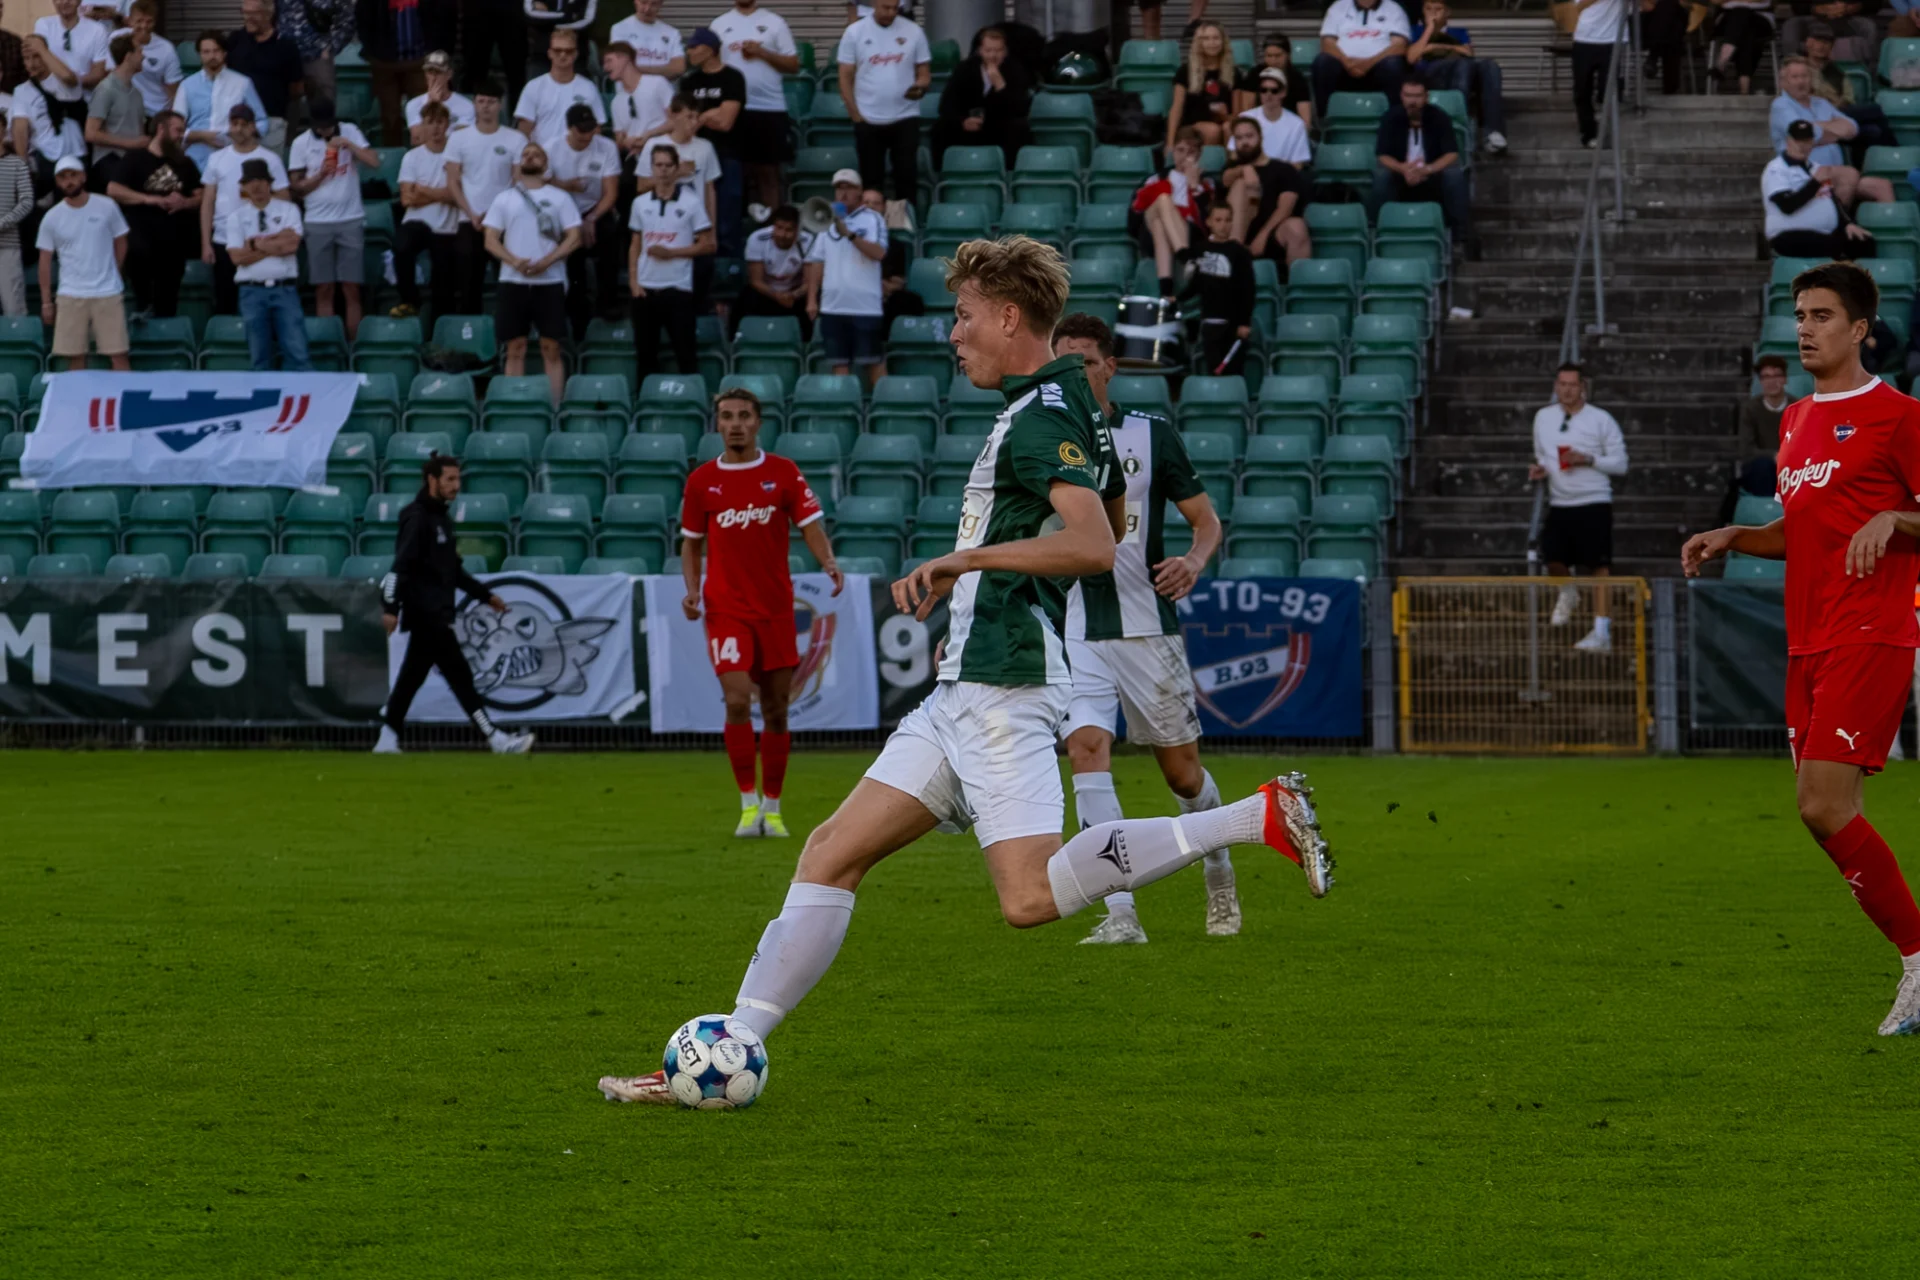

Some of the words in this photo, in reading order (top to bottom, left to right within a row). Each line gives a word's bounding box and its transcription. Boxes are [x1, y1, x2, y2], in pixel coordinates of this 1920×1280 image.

[711, 636, 741, 667] 14
[1213, 656, 1269, 686] B.93
[1117, 829, 1133, 874] SELECT
